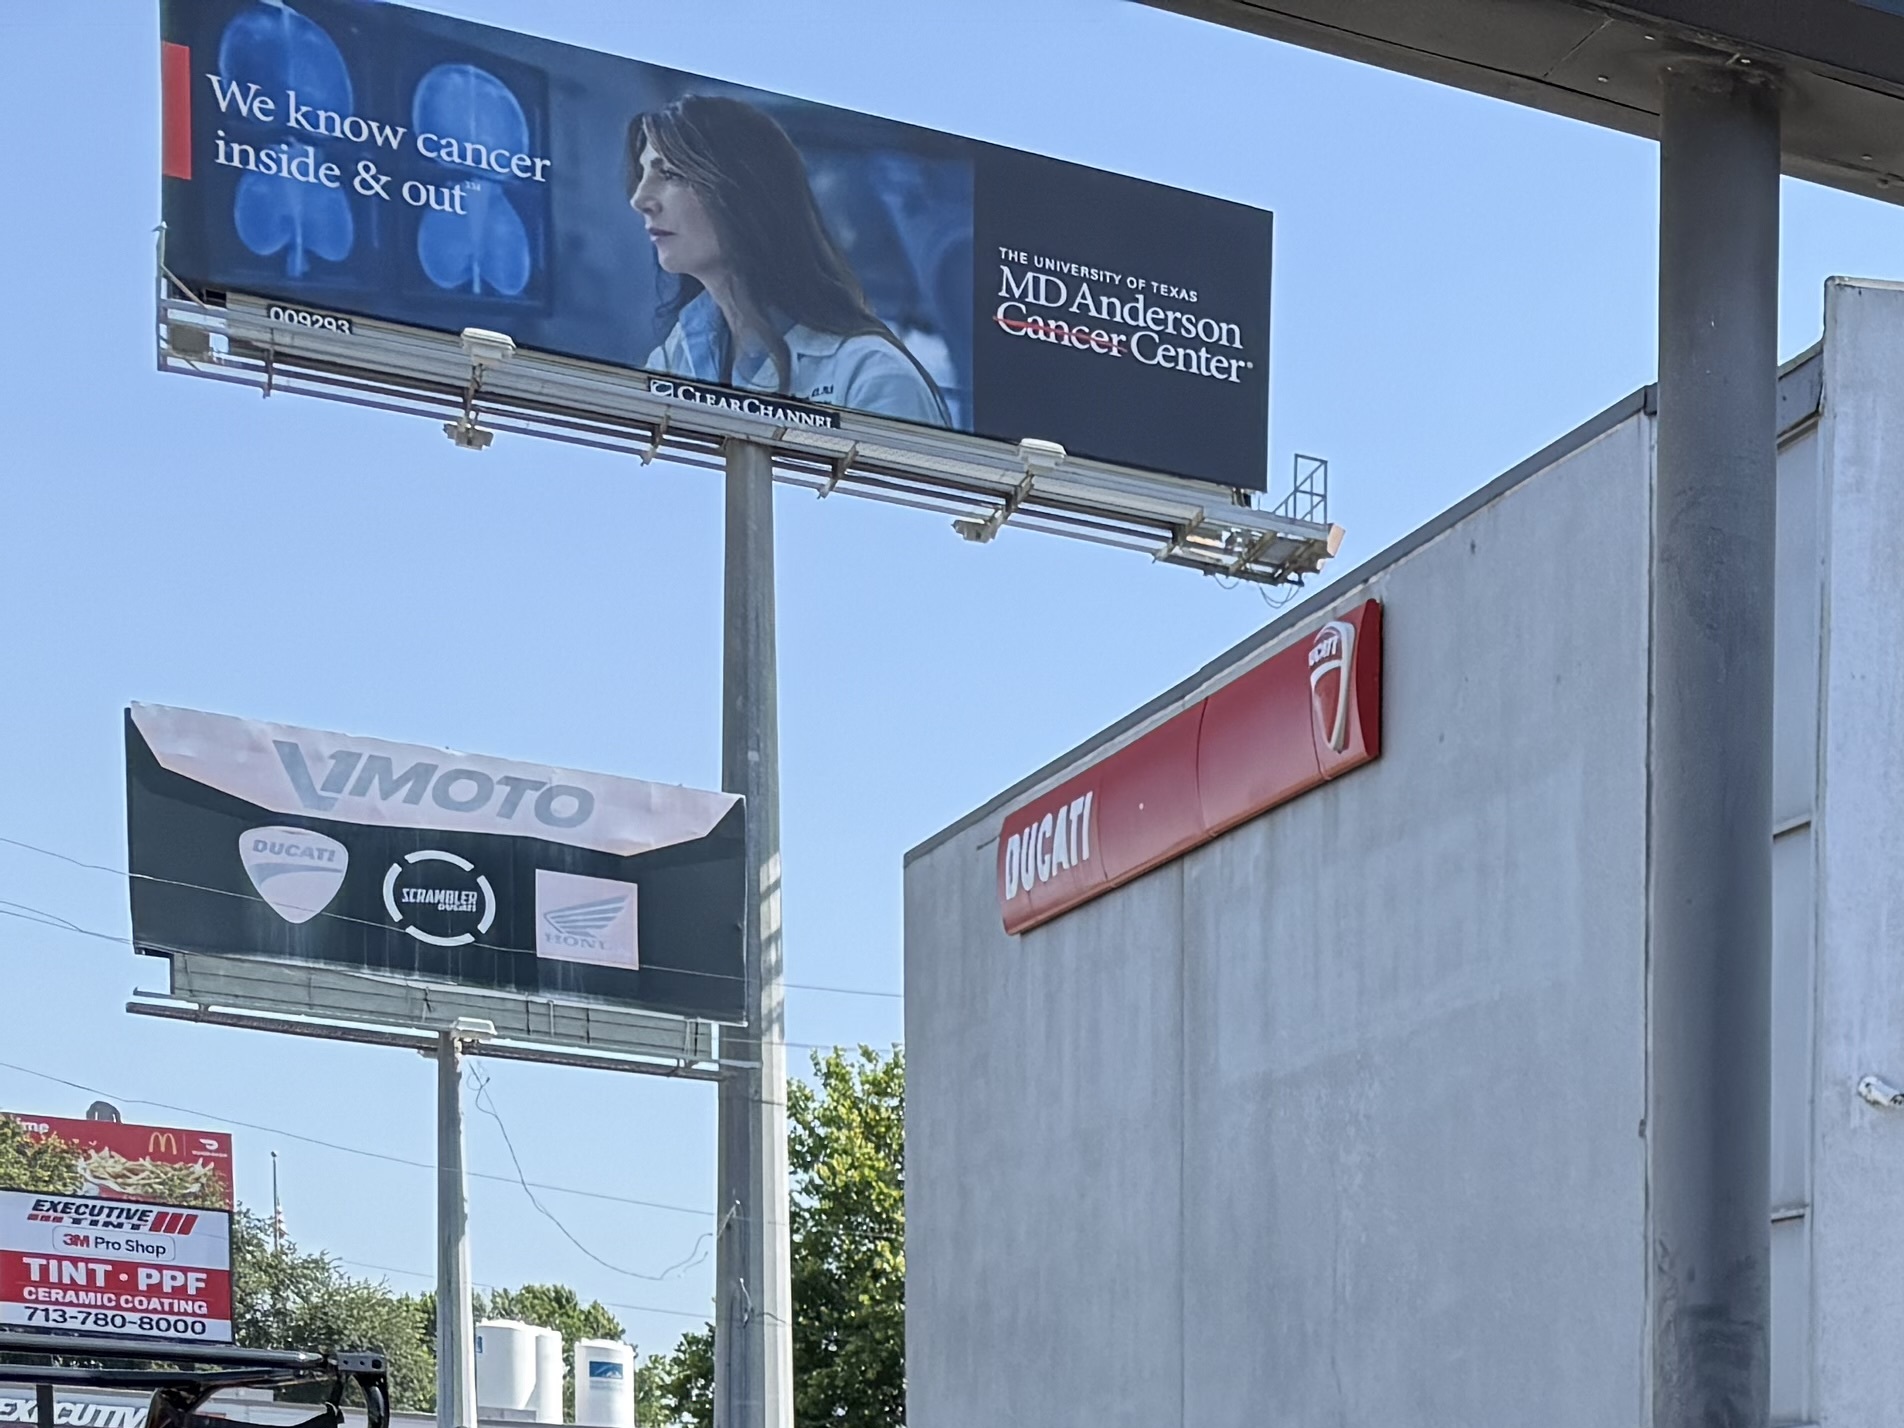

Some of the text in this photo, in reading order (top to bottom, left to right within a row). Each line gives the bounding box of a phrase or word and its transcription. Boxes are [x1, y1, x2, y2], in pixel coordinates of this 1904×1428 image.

[206, 73, 552, 183] We know cancer
[214, 129, 468, 216] inside & out
[999, 246, 1198, 303] THE UNIVERSITY OF TEXAS
[998, 264, 1244, 349] MD Anderson
[995, 301, 1247, 384] Cancer Center
[252, 838, 336, 863] DUCATI
[1005, 791, 1094, 901] DUCATI
[402, 887, 478, 905] SCRAMBLER
[31, 1198, 153, 1223] EXECUTIVE
[62, 1233, 167, 1258] 3M Pro Shop
[22, 1256, 207, 1295] TINT PPF
[23, 1286, 208, 1315] CERAMIC COATING
[24, 1305, 207, 1336] 713-780-8000
